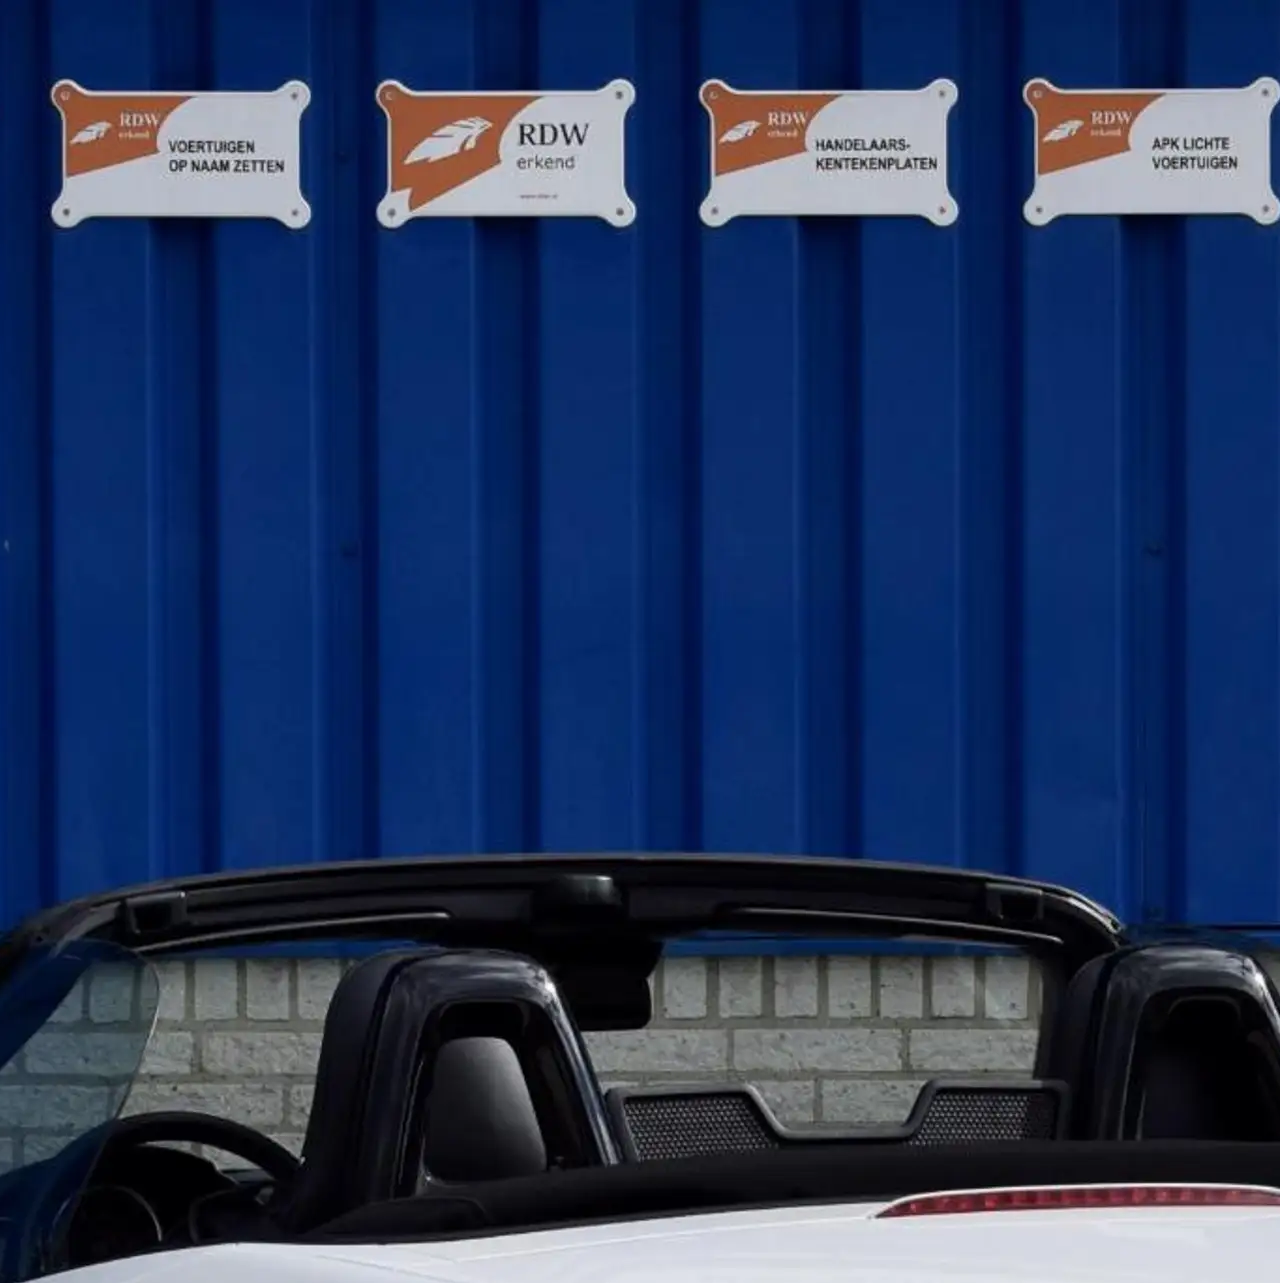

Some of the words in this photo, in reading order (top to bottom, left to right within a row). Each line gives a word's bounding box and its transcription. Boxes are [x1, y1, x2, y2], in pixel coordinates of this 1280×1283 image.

[119, 111, 161, 126] RDW
[767, 111, 807, 126] RDW
[1091, 110, 1133, 125] RDW
[518, 122, 589, 146] RDW
[168, 139, 256, 154] VOERTUIGEN
[815, 138, 911, 152] HANDELAARS-
[1152, 137, 1180, 151] APK
[1183, 136, 1231, 150] LICHTE
[168, 159, 187, 173] OP
[190, 159, 231, 173] NAAM
[234, 159, 285, 173] ZETTEN
[516, 154, 576, 170] erkend
[815, 156, 938, 171] KENTEKENPLATEN
[1152, 156, 1239, 170] VOERTUIGEN
